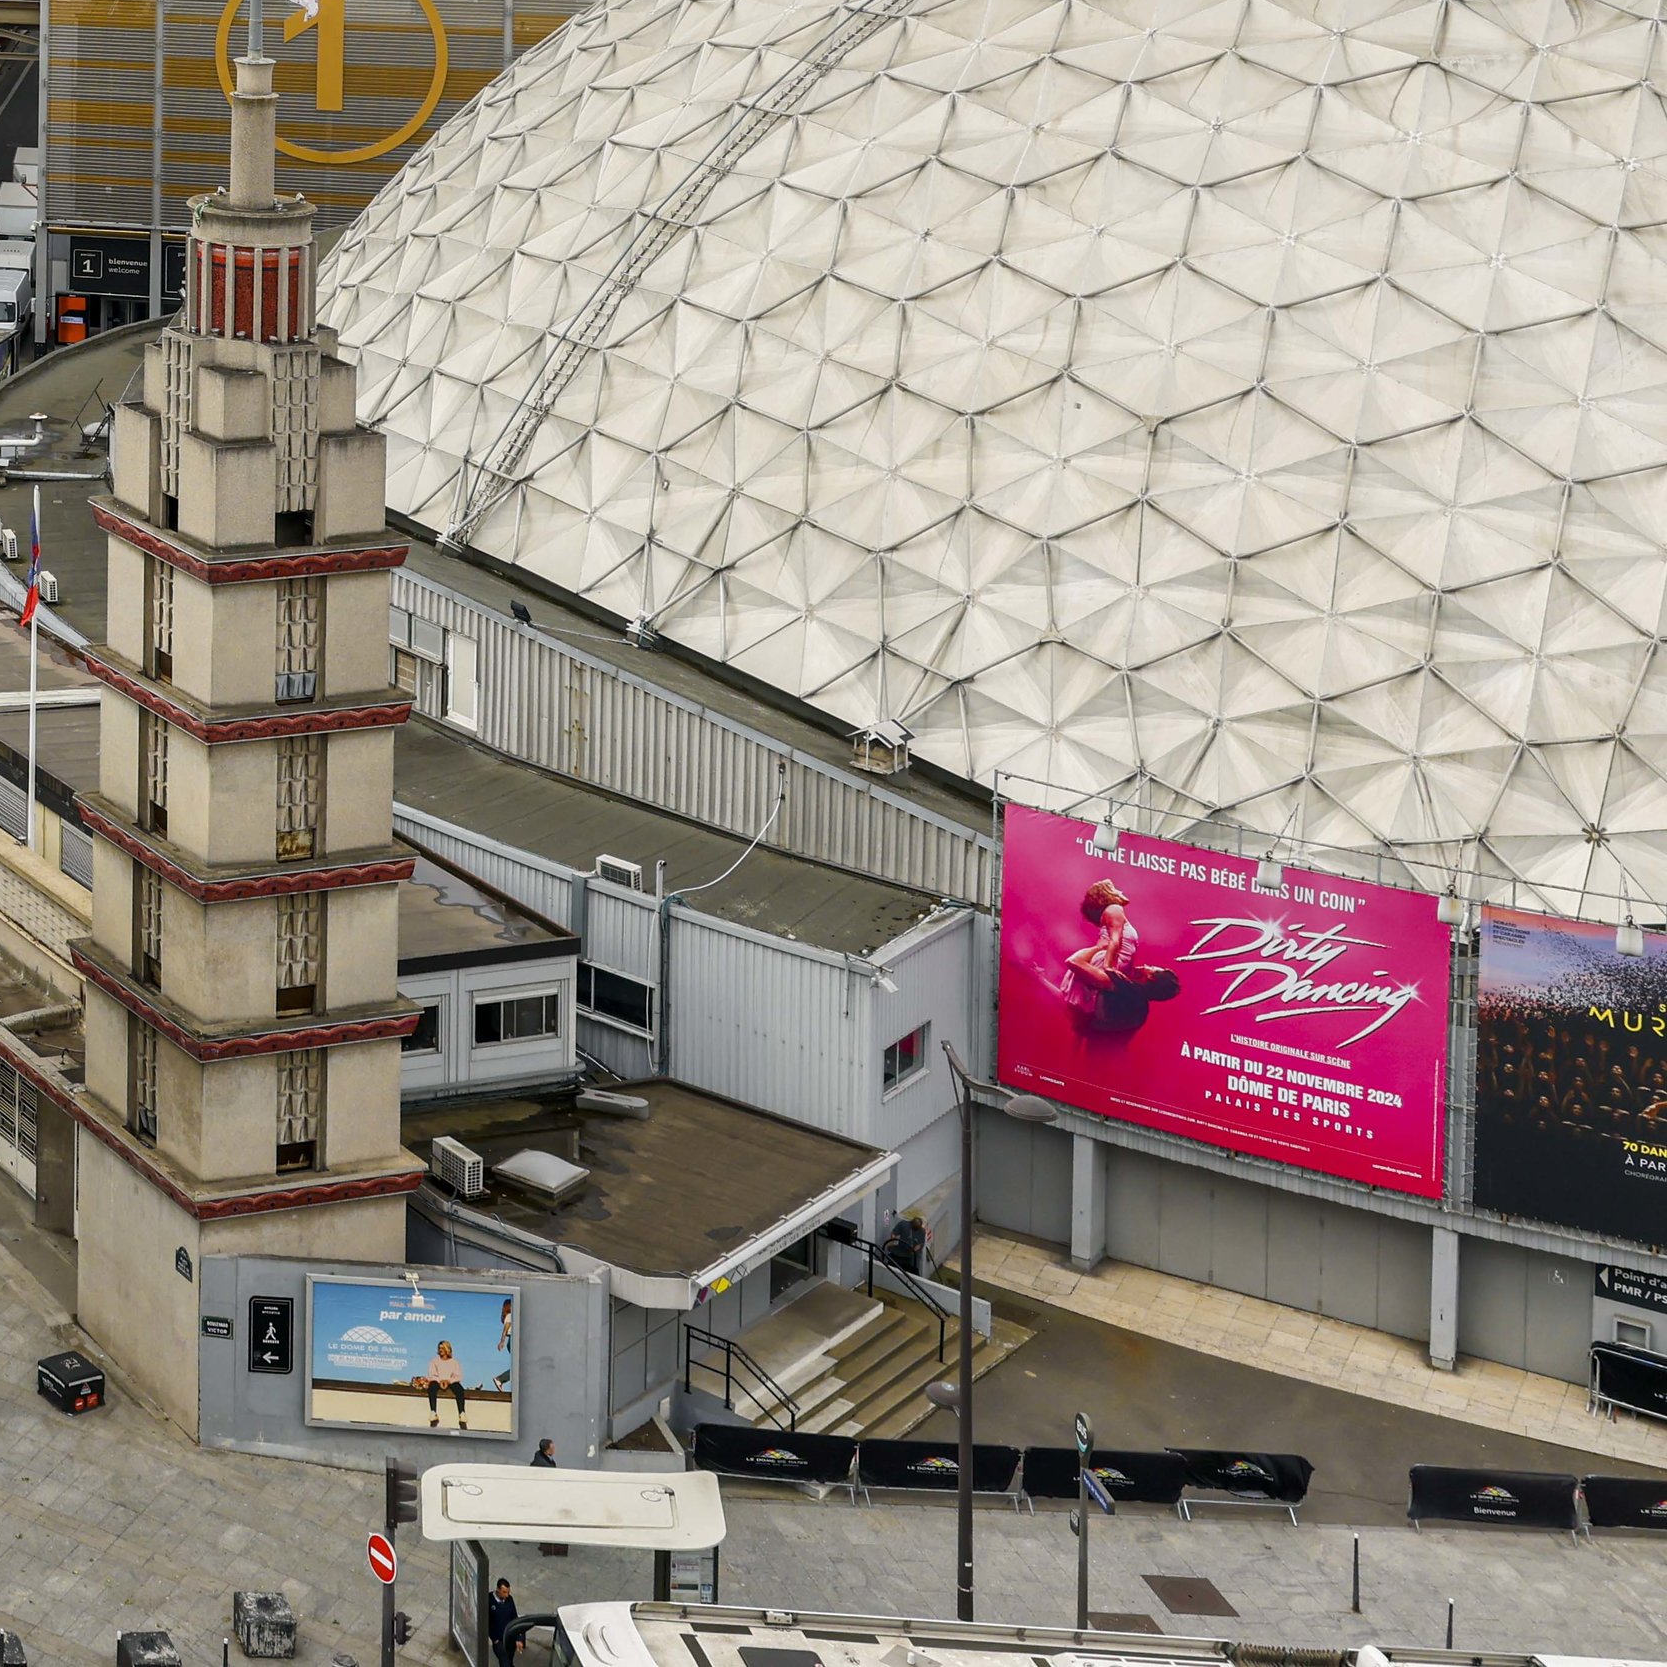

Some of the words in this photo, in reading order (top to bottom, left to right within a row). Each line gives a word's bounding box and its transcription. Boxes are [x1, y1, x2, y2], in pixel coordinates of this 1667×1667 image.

[82, 259, 94, 273] 1
[108, 258, 148, 267] bienvenue
[108, 267, 140, 275] welcome
[1108, 847, 1125, 864] NE
[1130, 850, 1176, 876] LAISSE
[1180, 863, 1207, 882] PAS
[1211, 868, 1246, 892] BÉBÉ
[1294, 886, 1315, 905] UN
[1174, 917, 1393, 978] Dirty
[1199, 961, 1413, 1049] Dancing
[1589, 1006, 1666, 1038] MUR
[1230, 1034, 1269, 1050] L'HISTOIRE
[1270, 1042, 1309, 1059] ORIGINALE
[1310, 1052, 1326, 1063] SUR
[1327, 1054, 1352, 1070] SCÈNE
[1180, 1041, 1191, 1058] À
[1193, 1047, 1241, 1071] PARTIR
[1244, 1059, 1263, 1075] DU
[1266, 1065, 1283, 1081] 22
[1286, 1069, 1363, 1099] NOVEMBRE
[1367, 1088, 1402, 1108] 2024
[1227, 1075, 1274, 1100] DÔME
[1277, 1088, 1298, 1106] DE
[1302, 1094, 1350, 1118] PARIS
[1204, 1090, 1261, 1112] PALAIS
[1272, 1108, 1301, 1122] DES
[1312, 1116, 1374, 1140] SPORTS
[1622, 1141, 1638, 1152] 70
[1641, 1145, 1667, 1158] DAN
[1625, 1154, 1634, 1166] À
[1639, 1158, 1666, 1172] PAR
[1614, 1268, 1646, 1284] Point
[1614, 1283, 1642, 1298] PMR
[380, 1310, 401, 1322] par
[404, 1312, 446, 1323] amour
[207, 1327, 228, 1335] VICTOR
[1473, 1506, 1516, 1518] Bienvenue
